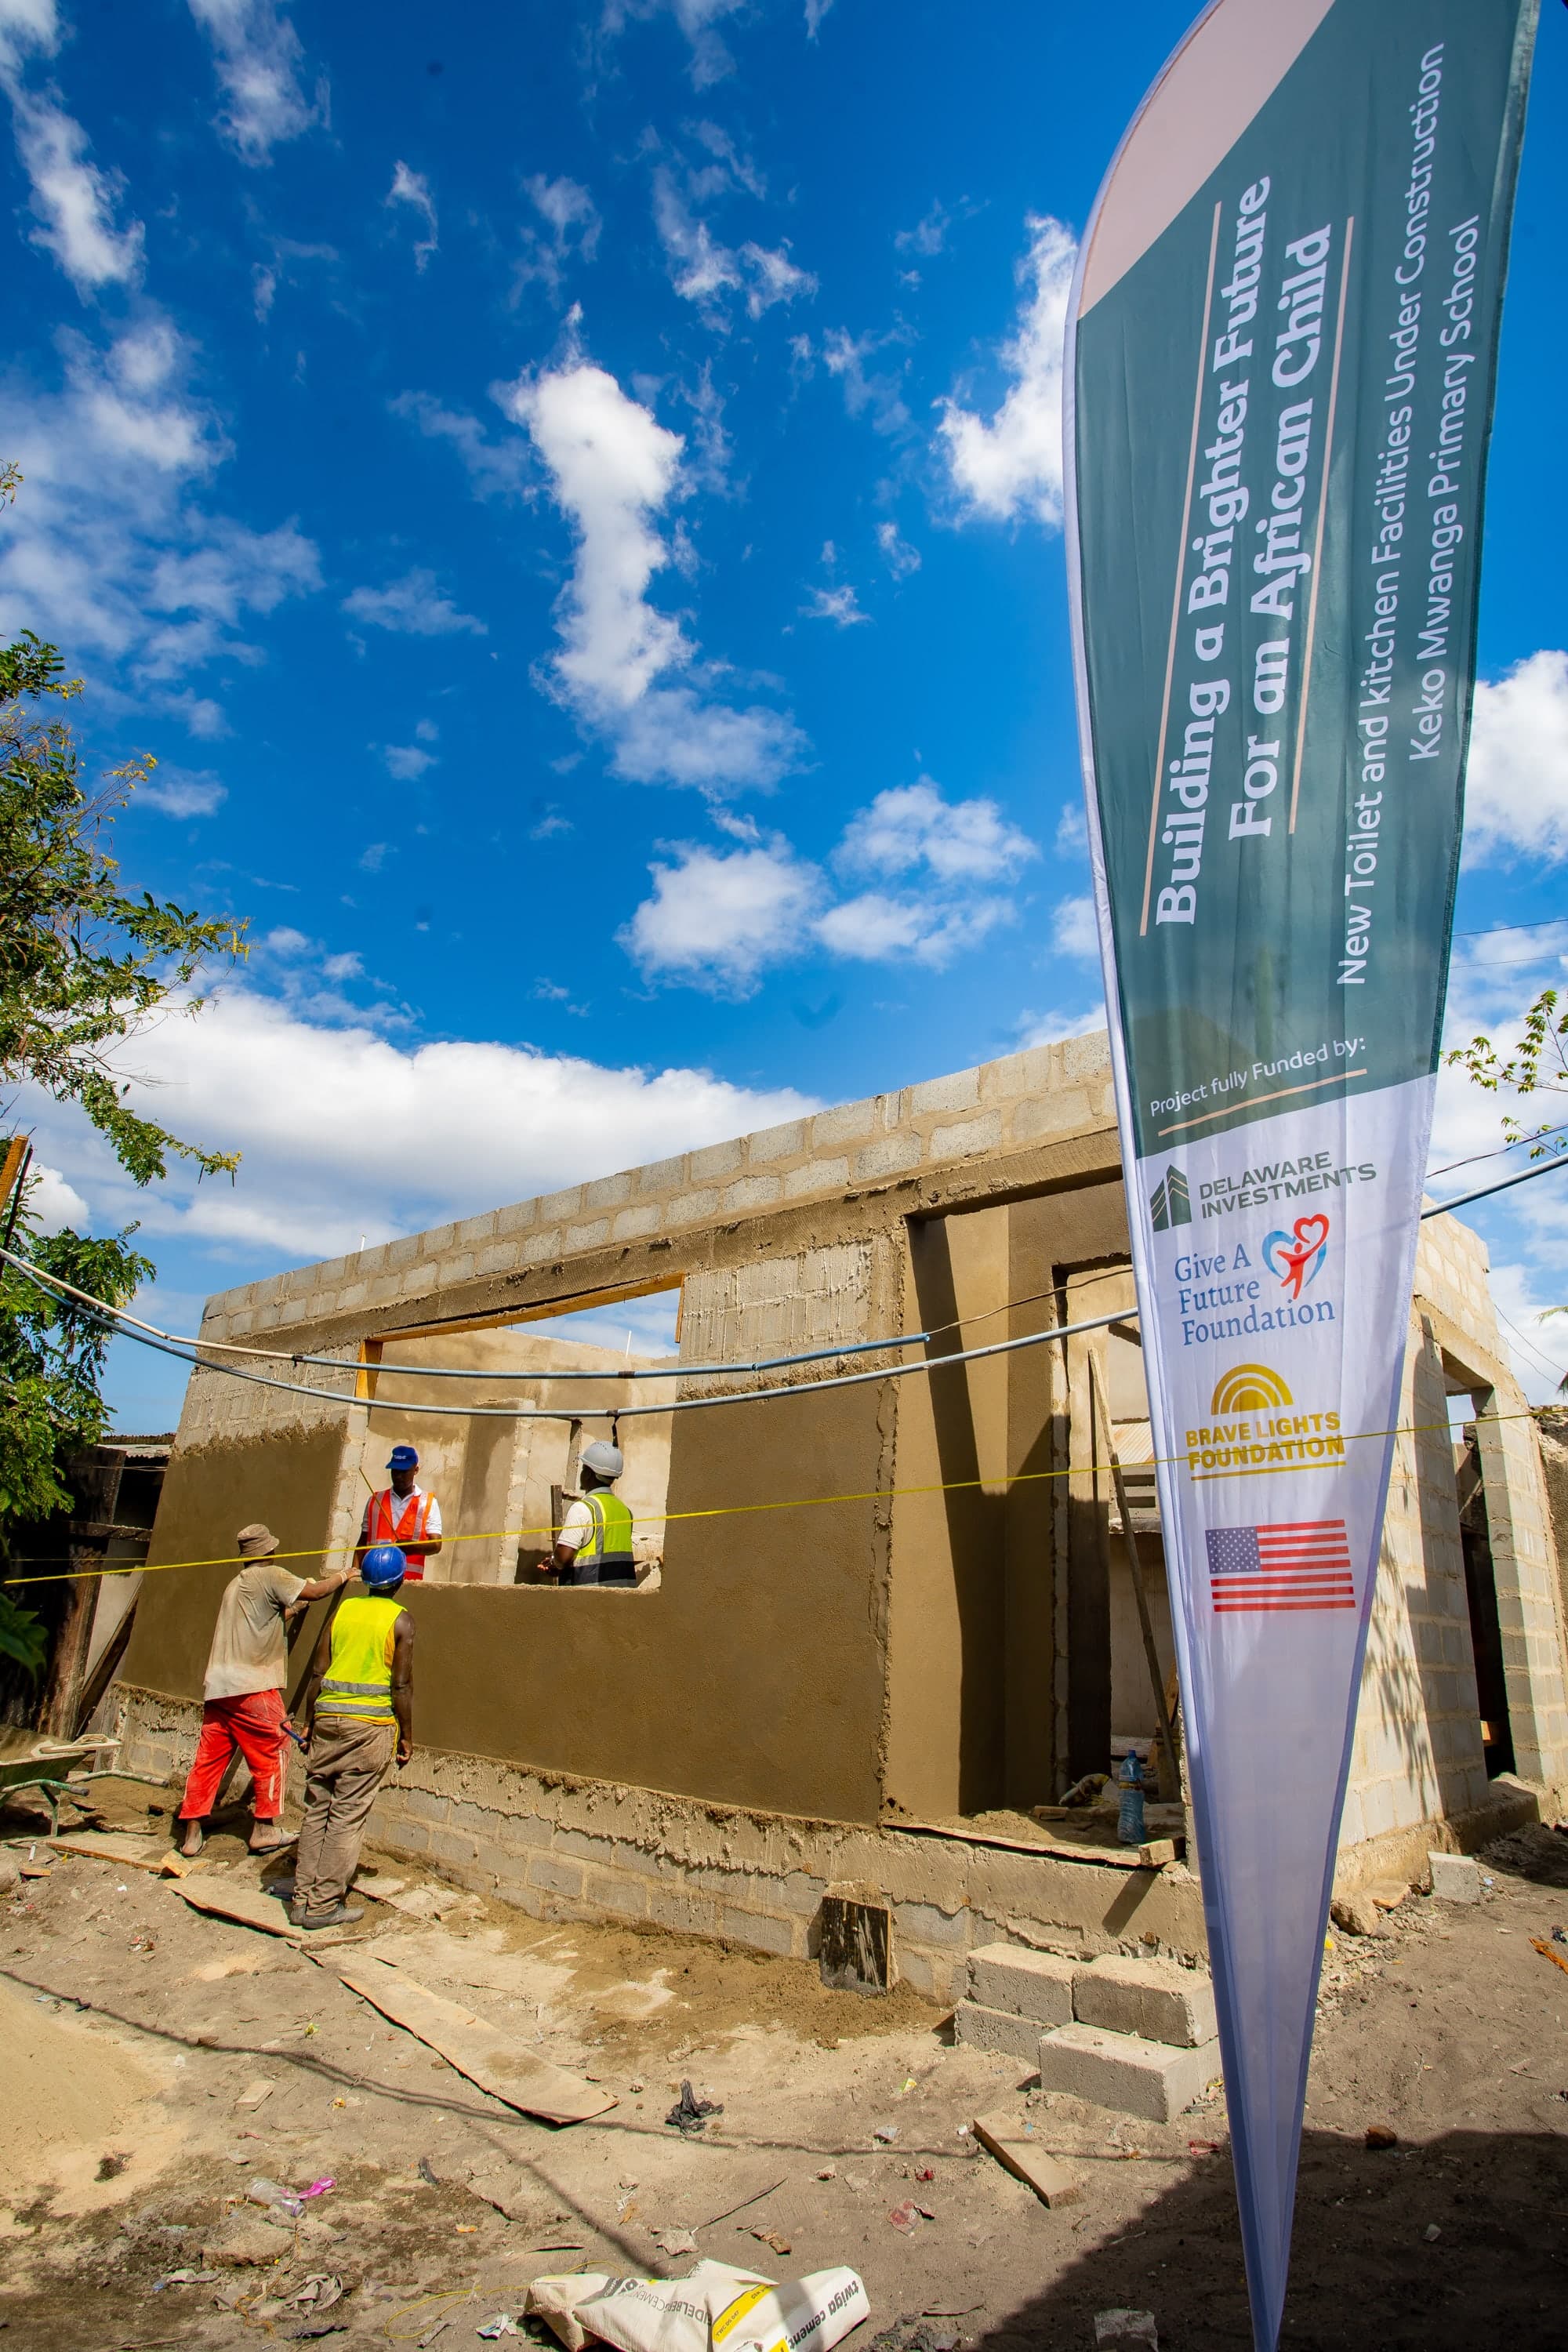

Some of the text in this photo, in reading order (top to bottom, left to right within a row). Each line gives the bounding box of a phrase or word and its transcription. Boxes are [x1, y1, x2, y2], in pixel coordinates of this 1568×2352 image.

[1409, 214, 1479, 760] Keko Mwanga Primary School
[1228, 223, 1331, 841] For an African Child
[1337, 42, 1444, 985] New Toilet and kitchen Facilities Under Construction
[1155, 176, 1271, 925] Building a Brighter Future
[1150, 1037, 1367, 1117] Project fully Funded by:
[1199, 1151, 1333, 1200] DELAWARE
[1200, 1163, 1377, 1219] INVESTMENTS
[1174, 1243, 1253, 1282] Give A
[1178, 1279, 1261, 1315] Future
[1181, 1298, 1336, 1346] Foundation
[1185, 1411, 1341, 1448] BRAVE LIGHTS
[1187, 1434, 1346, 1471] FOUNDATION
[827, 2279, 860, 2316] twiga
